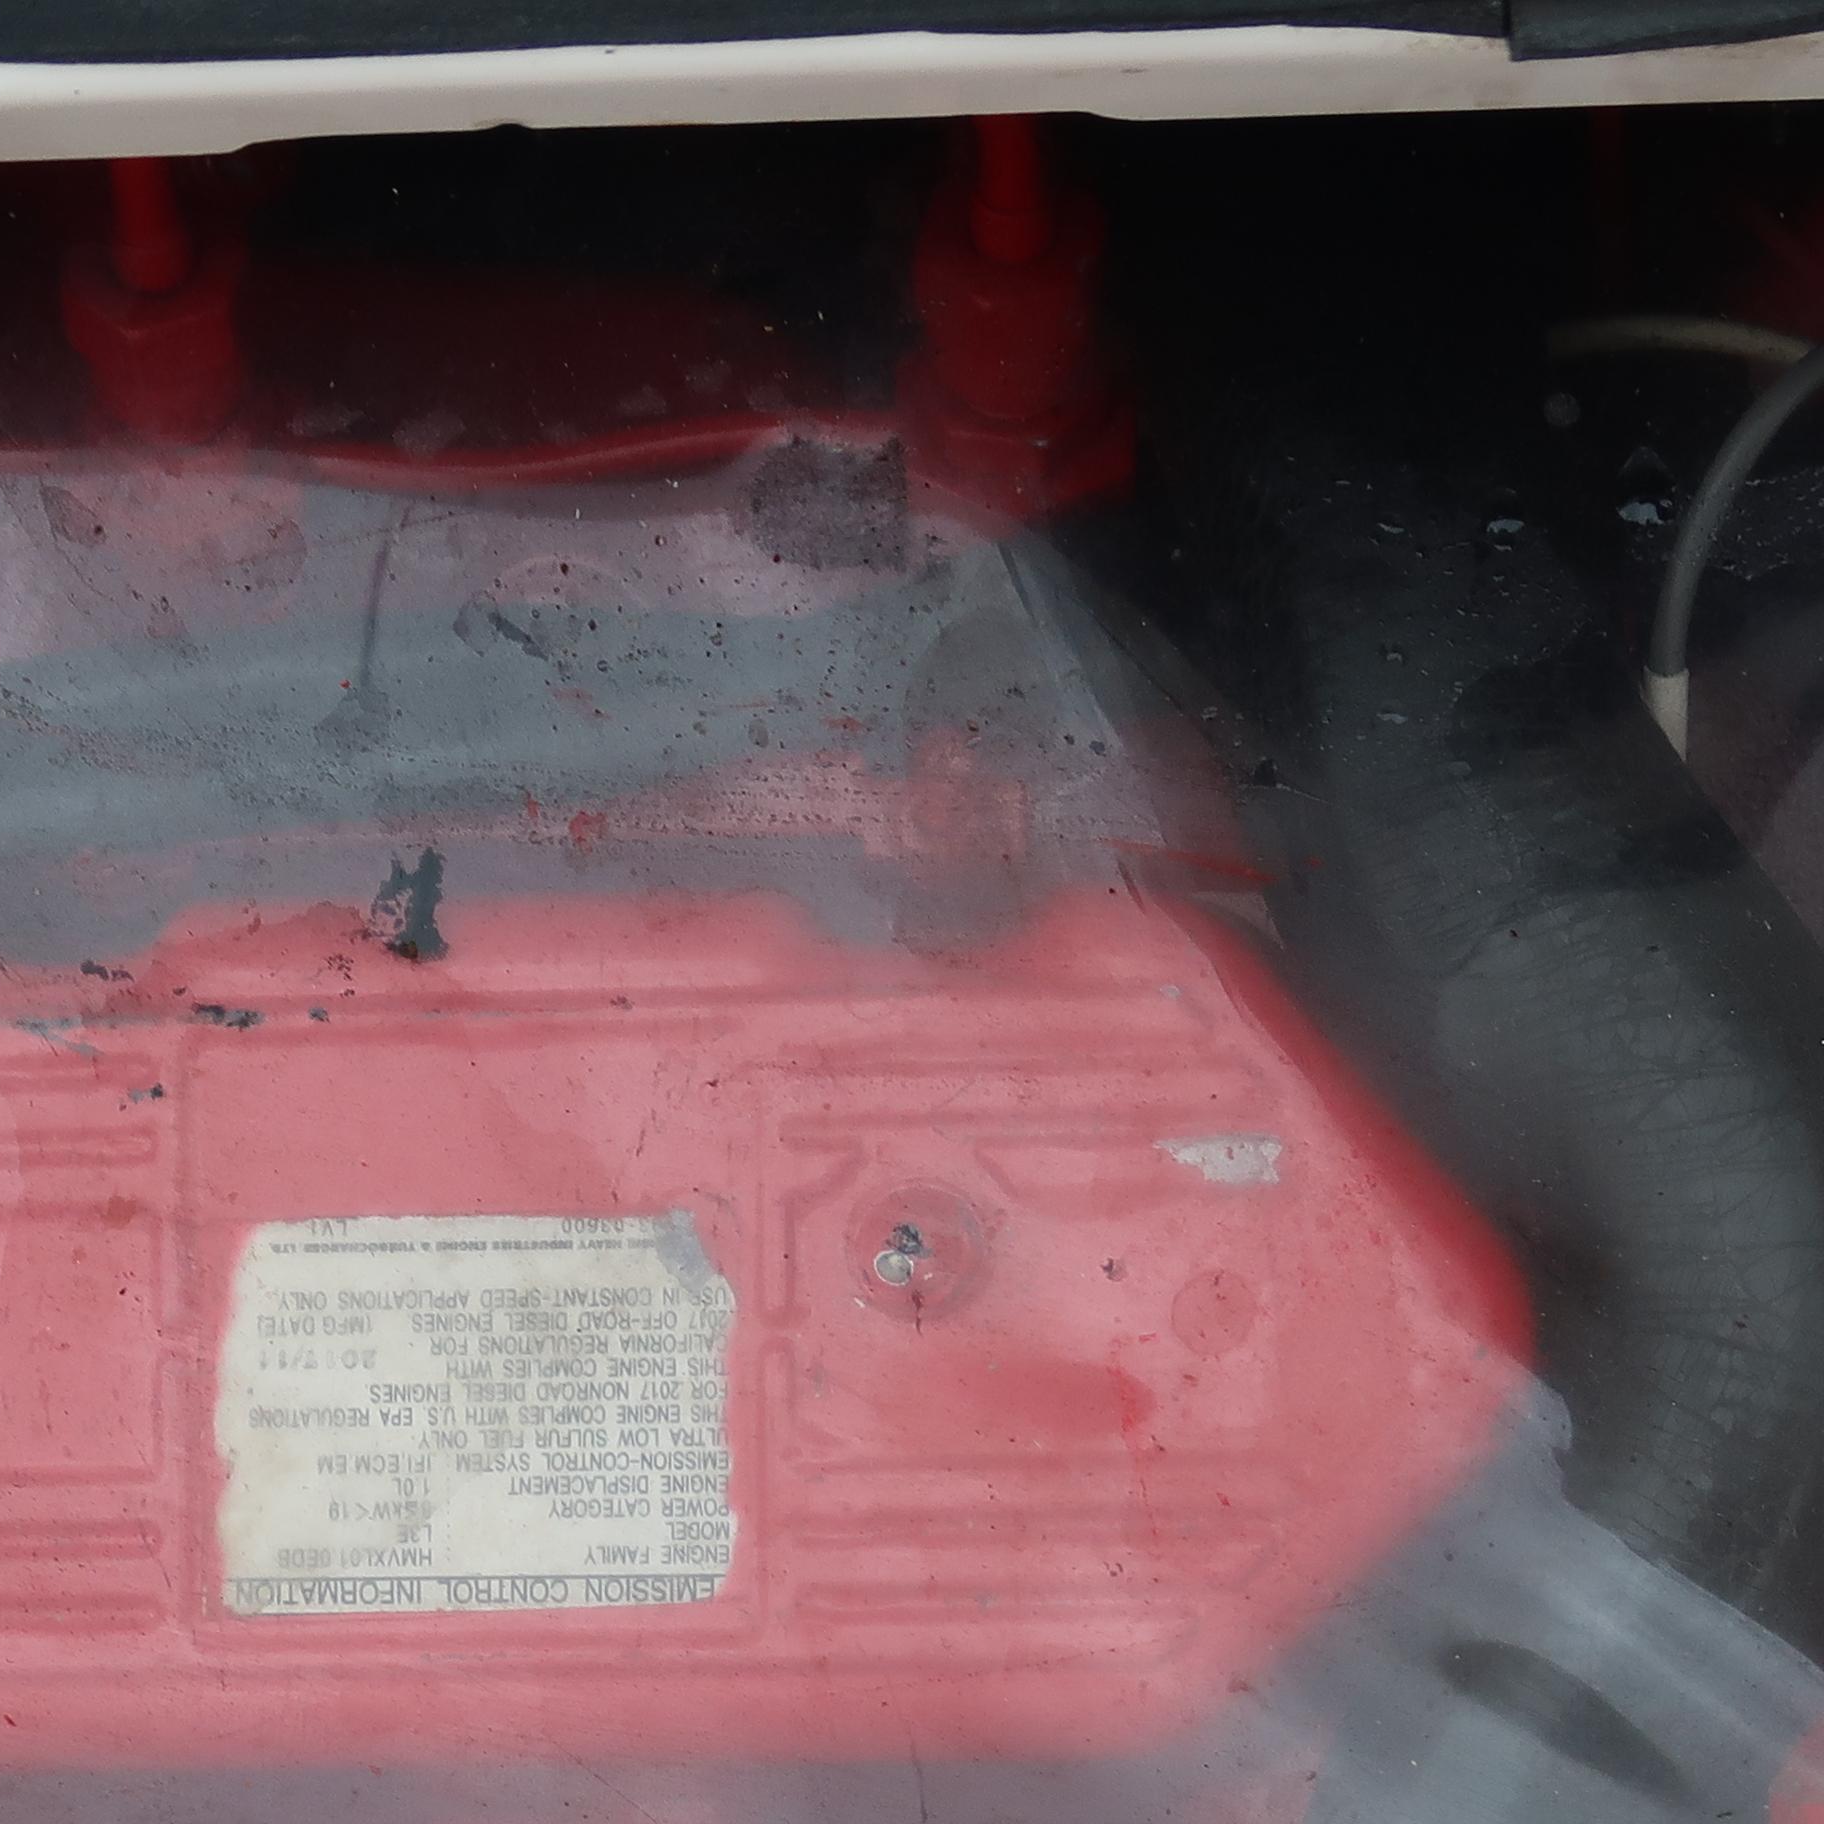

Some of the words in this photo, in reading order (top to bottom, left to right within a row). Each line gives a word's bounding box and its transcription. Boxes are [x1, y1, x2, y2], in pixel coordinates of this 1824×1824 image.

[579, 1238, 621, 1249] HEAVY
[336, 1290, 470, 1310] APPLICATIONS
[480, 1288, 652, 1308] CONSTANT-SPEED
[661, 1286, 680, 1305] IN
[257, 1315, 314, 1335] DATE)
[322, 1315, 372, 1334] (MFG
[502, 1313, 568, 1330] DIESEL
[578, 1311, 677, 1330] OFF-ROAD
[686, 1310, 728, 1329] 2017
[430, 1336, 469, 1354] FOR
[477, 1335, 608, 1354] REGULATIONS
[619, 1334, 727, 1353] CALIFORNIA
[445, 1360, 492, 1378] WITH
[501, 1359, 597, 1377] COMPLIES
[607, 1357, 676, 1376] ENGINE
[688, 1357, 727, 1376] THIS
[364, 1383, 451, 1403] ENGINES.
[461, 1383, 526, 1402] DIESEL
[534, 1382, 629, 1401] NONROAD
[639, 1382, 682, 1400] 2017
[689, 1382, 728, 1400] FOR
[249, 1408, 370, 1427] REGULATIONS
[379, 1408, 413, 1426] EPA
[423, 1406, 455, 1425] U.S.
[464, 1406, 509, 1425] WITH
[518, 1405, 606, 1424] COMPLIES
[615, 1405, 681, 1424] ENGINE
[689, 1405, 727, 1423] THIS
[477, 1429, 523, 1449] FUEL
[534, 1428, 607, 1448] SULFUR
[619, 1428, 659, 1448] LOW
[669, 1428, 729, 1448] ULTRA
[456, 1453, 530, 1471] SYSTEM
[541, 1451, 729, 1471] EMISSION-CONTROL
[508, 1475, 649, 1494] DISPLACEMENT
[660, 1474, 729, 1493] ENGINE
[549, 1498, 650, 1518] CATEGORY
[659, 1498, 729, 1517] POWER
[396, 1525, 431, 1541] L3E
[666, 1521, 729, 1540] MODEL
[584, 1546, 649, 1564] FAMILY
[661, 1544, 729, 1564] ENGINE
[235, 1579, 421, 1604] INFORMATION
[439, 1579, 568, 1602] CONTROL
[584, 1579, 715, 1602] EMISSION
